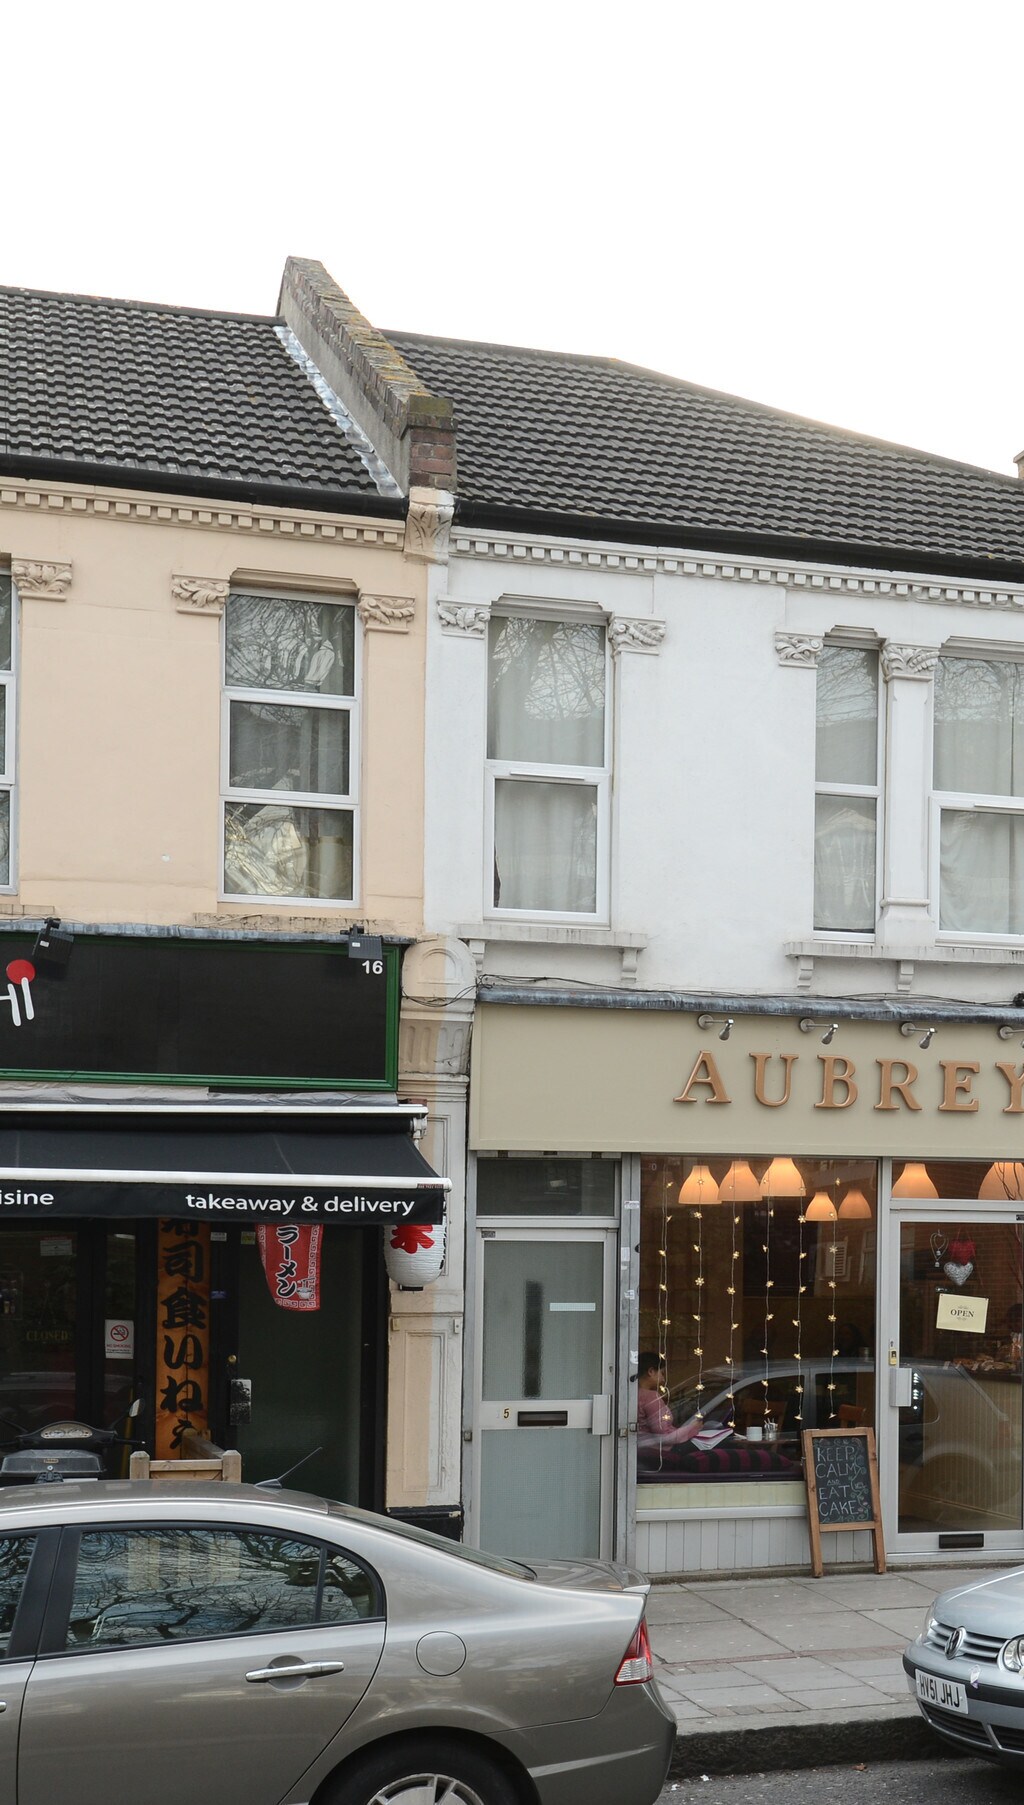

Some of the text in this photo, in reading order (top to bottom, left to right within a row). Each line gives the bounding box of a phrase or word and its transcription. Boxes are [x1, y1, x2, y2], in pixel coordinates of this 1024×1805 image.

[362, 960, 383, 974] 16
[185, 1193, 415, 1216] takeaway & delivery
[275, 1225, 299, 1298] ラーメン
[950, 1309, 974, 1317] OPEN
[26, 1330, 69, 1341] CLOSED
[503, 1408, 510, 1419] 5
[817, 1446, 855, 1461] KEEP
[815, 1463, 858, 1478] CALM
[818, 1485, 850, 1500] EAT
[819, 1500, 859, 1516] CAKE
[940, 1682, 960, 1708] JHJ
